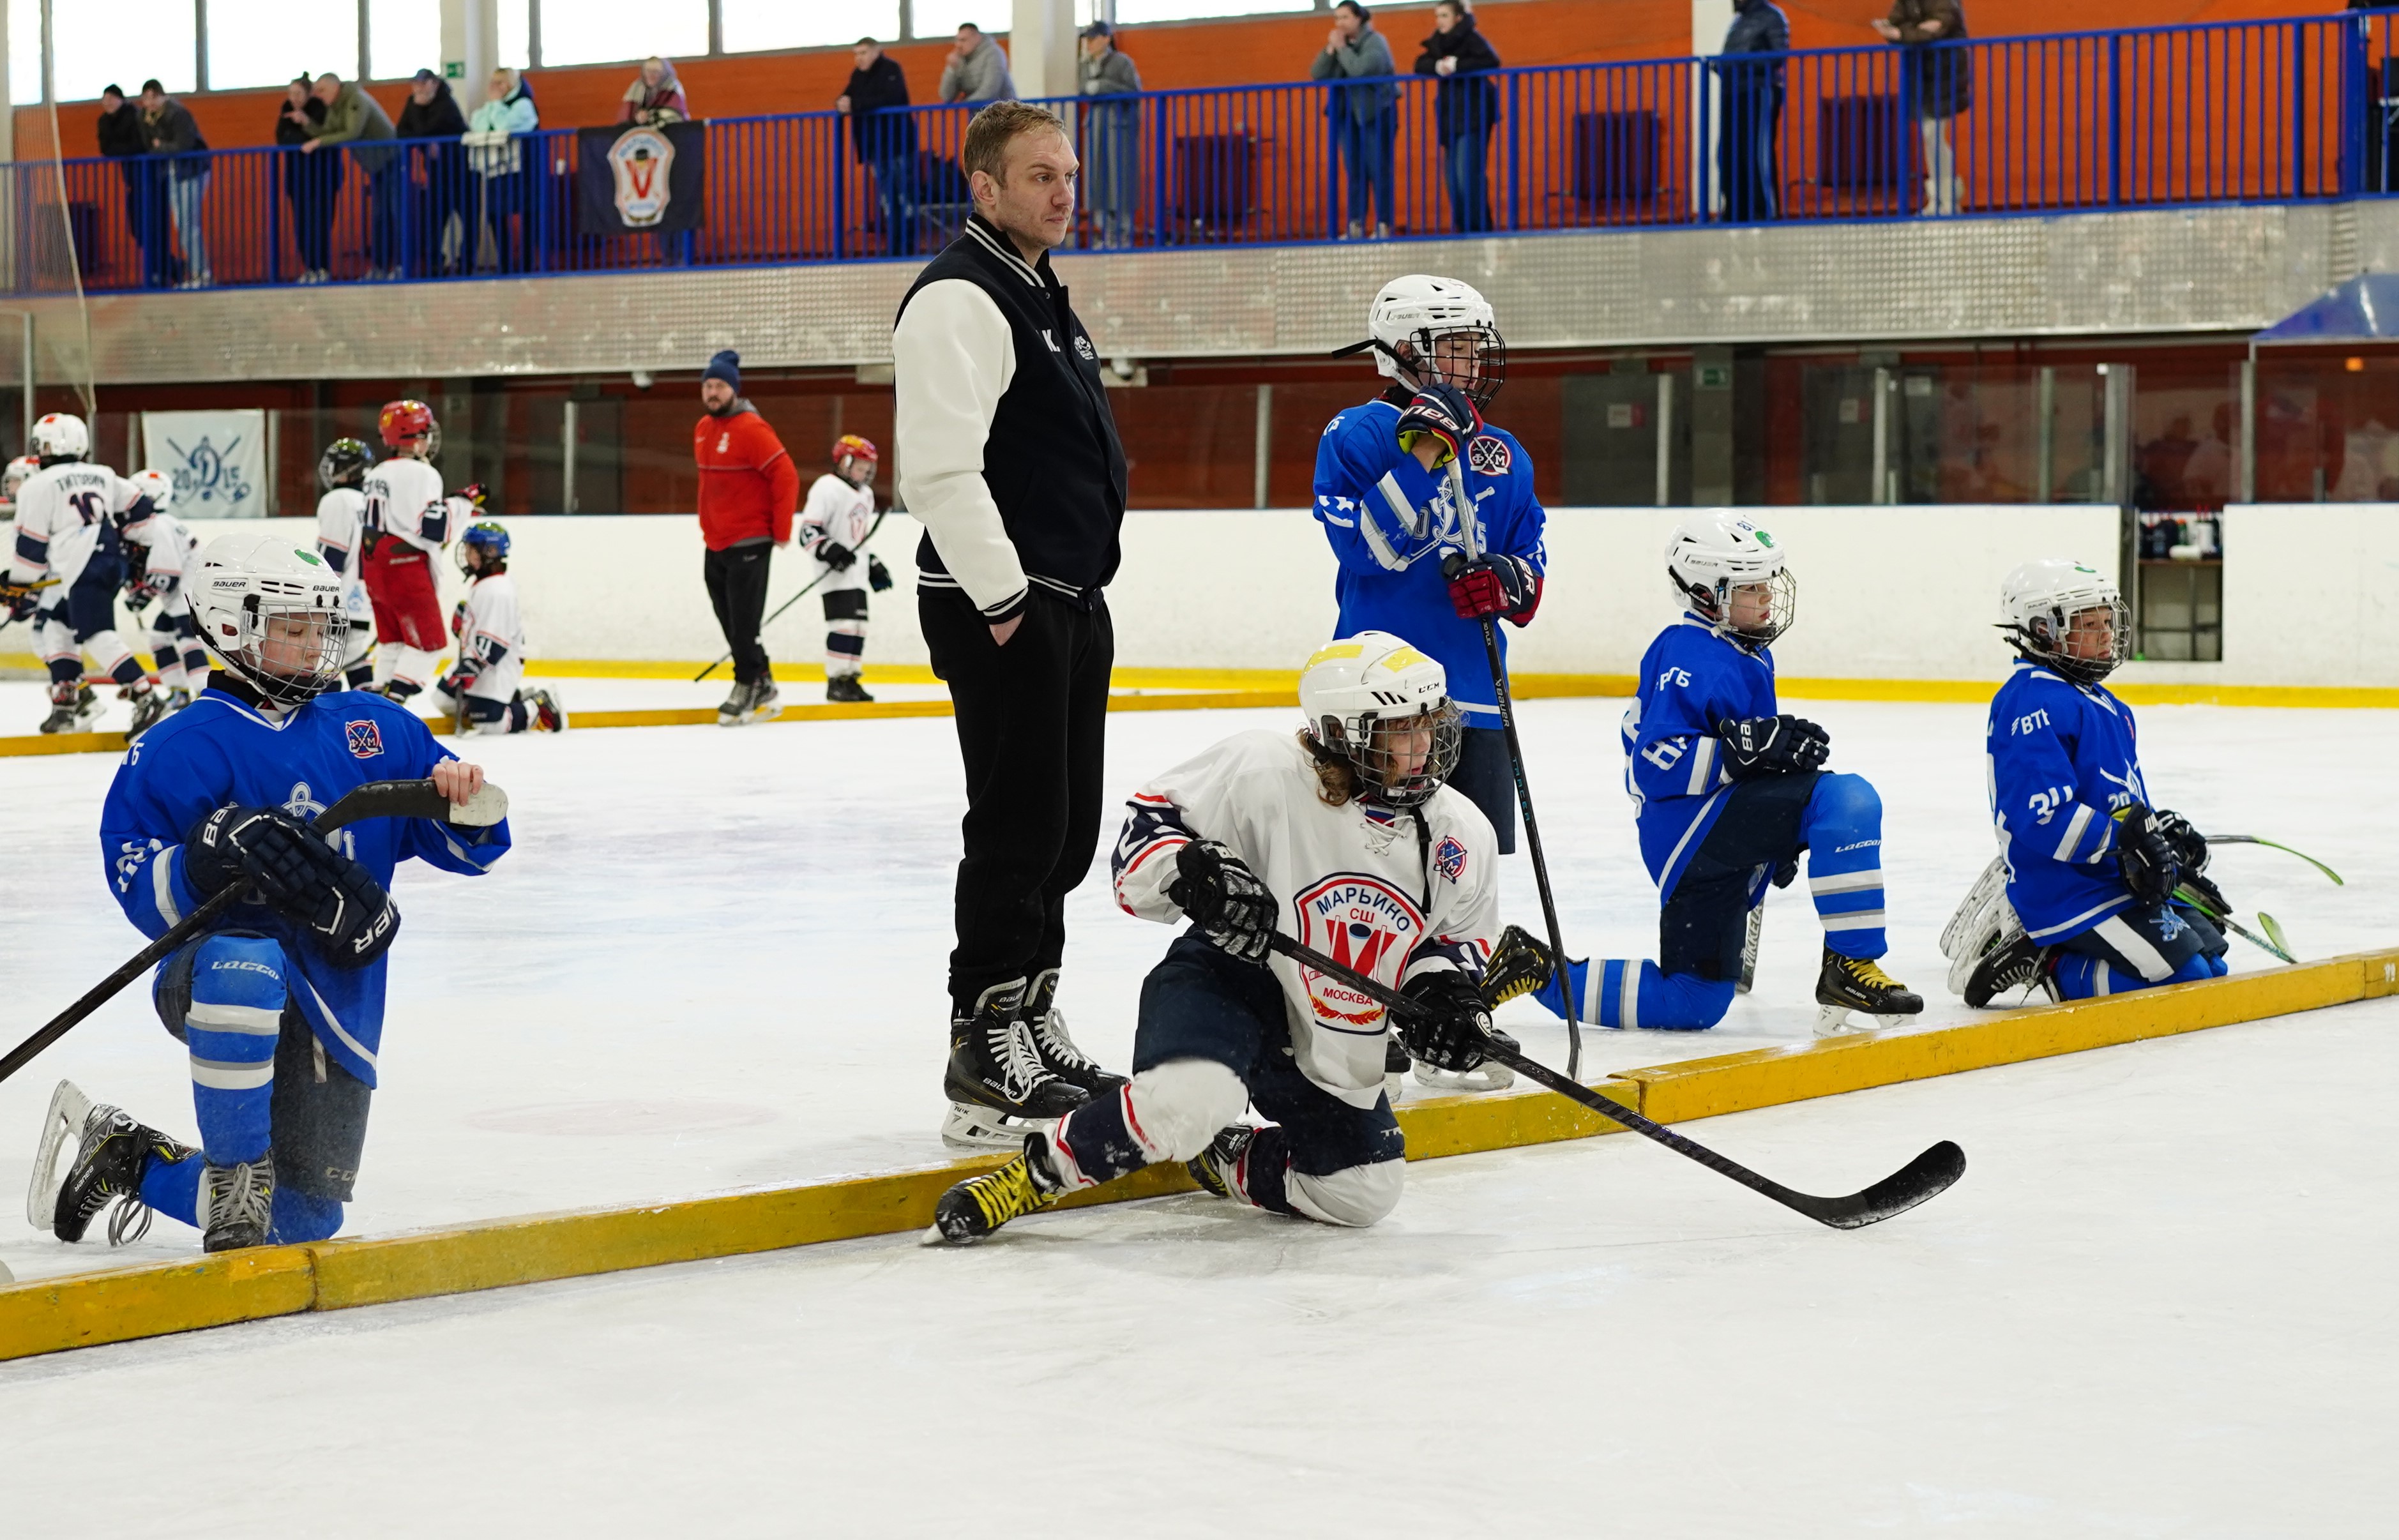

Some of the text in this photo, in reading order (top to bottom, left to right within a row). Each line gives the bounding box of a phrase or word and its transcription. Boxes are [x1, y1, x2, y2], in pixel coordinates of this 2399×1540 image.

[1472, 453, 1506, 466] ФХМ
[1736, 520, 1757, 532] 81
[213, 644, 240, 667] BAUER
[1419, 682, 1439, 693] CCM
[1495, 687, 1510, 728] BAUER
[1316, 887, 1410, 932] МАРЬИНО
[1349, 907, 1375, 924] СШ
[1322, 987, 1374, 1006] МОСКВА
[1845, 986, 1867, 1000] BAUER
[74, 1165, 95, 1192] BAUER
